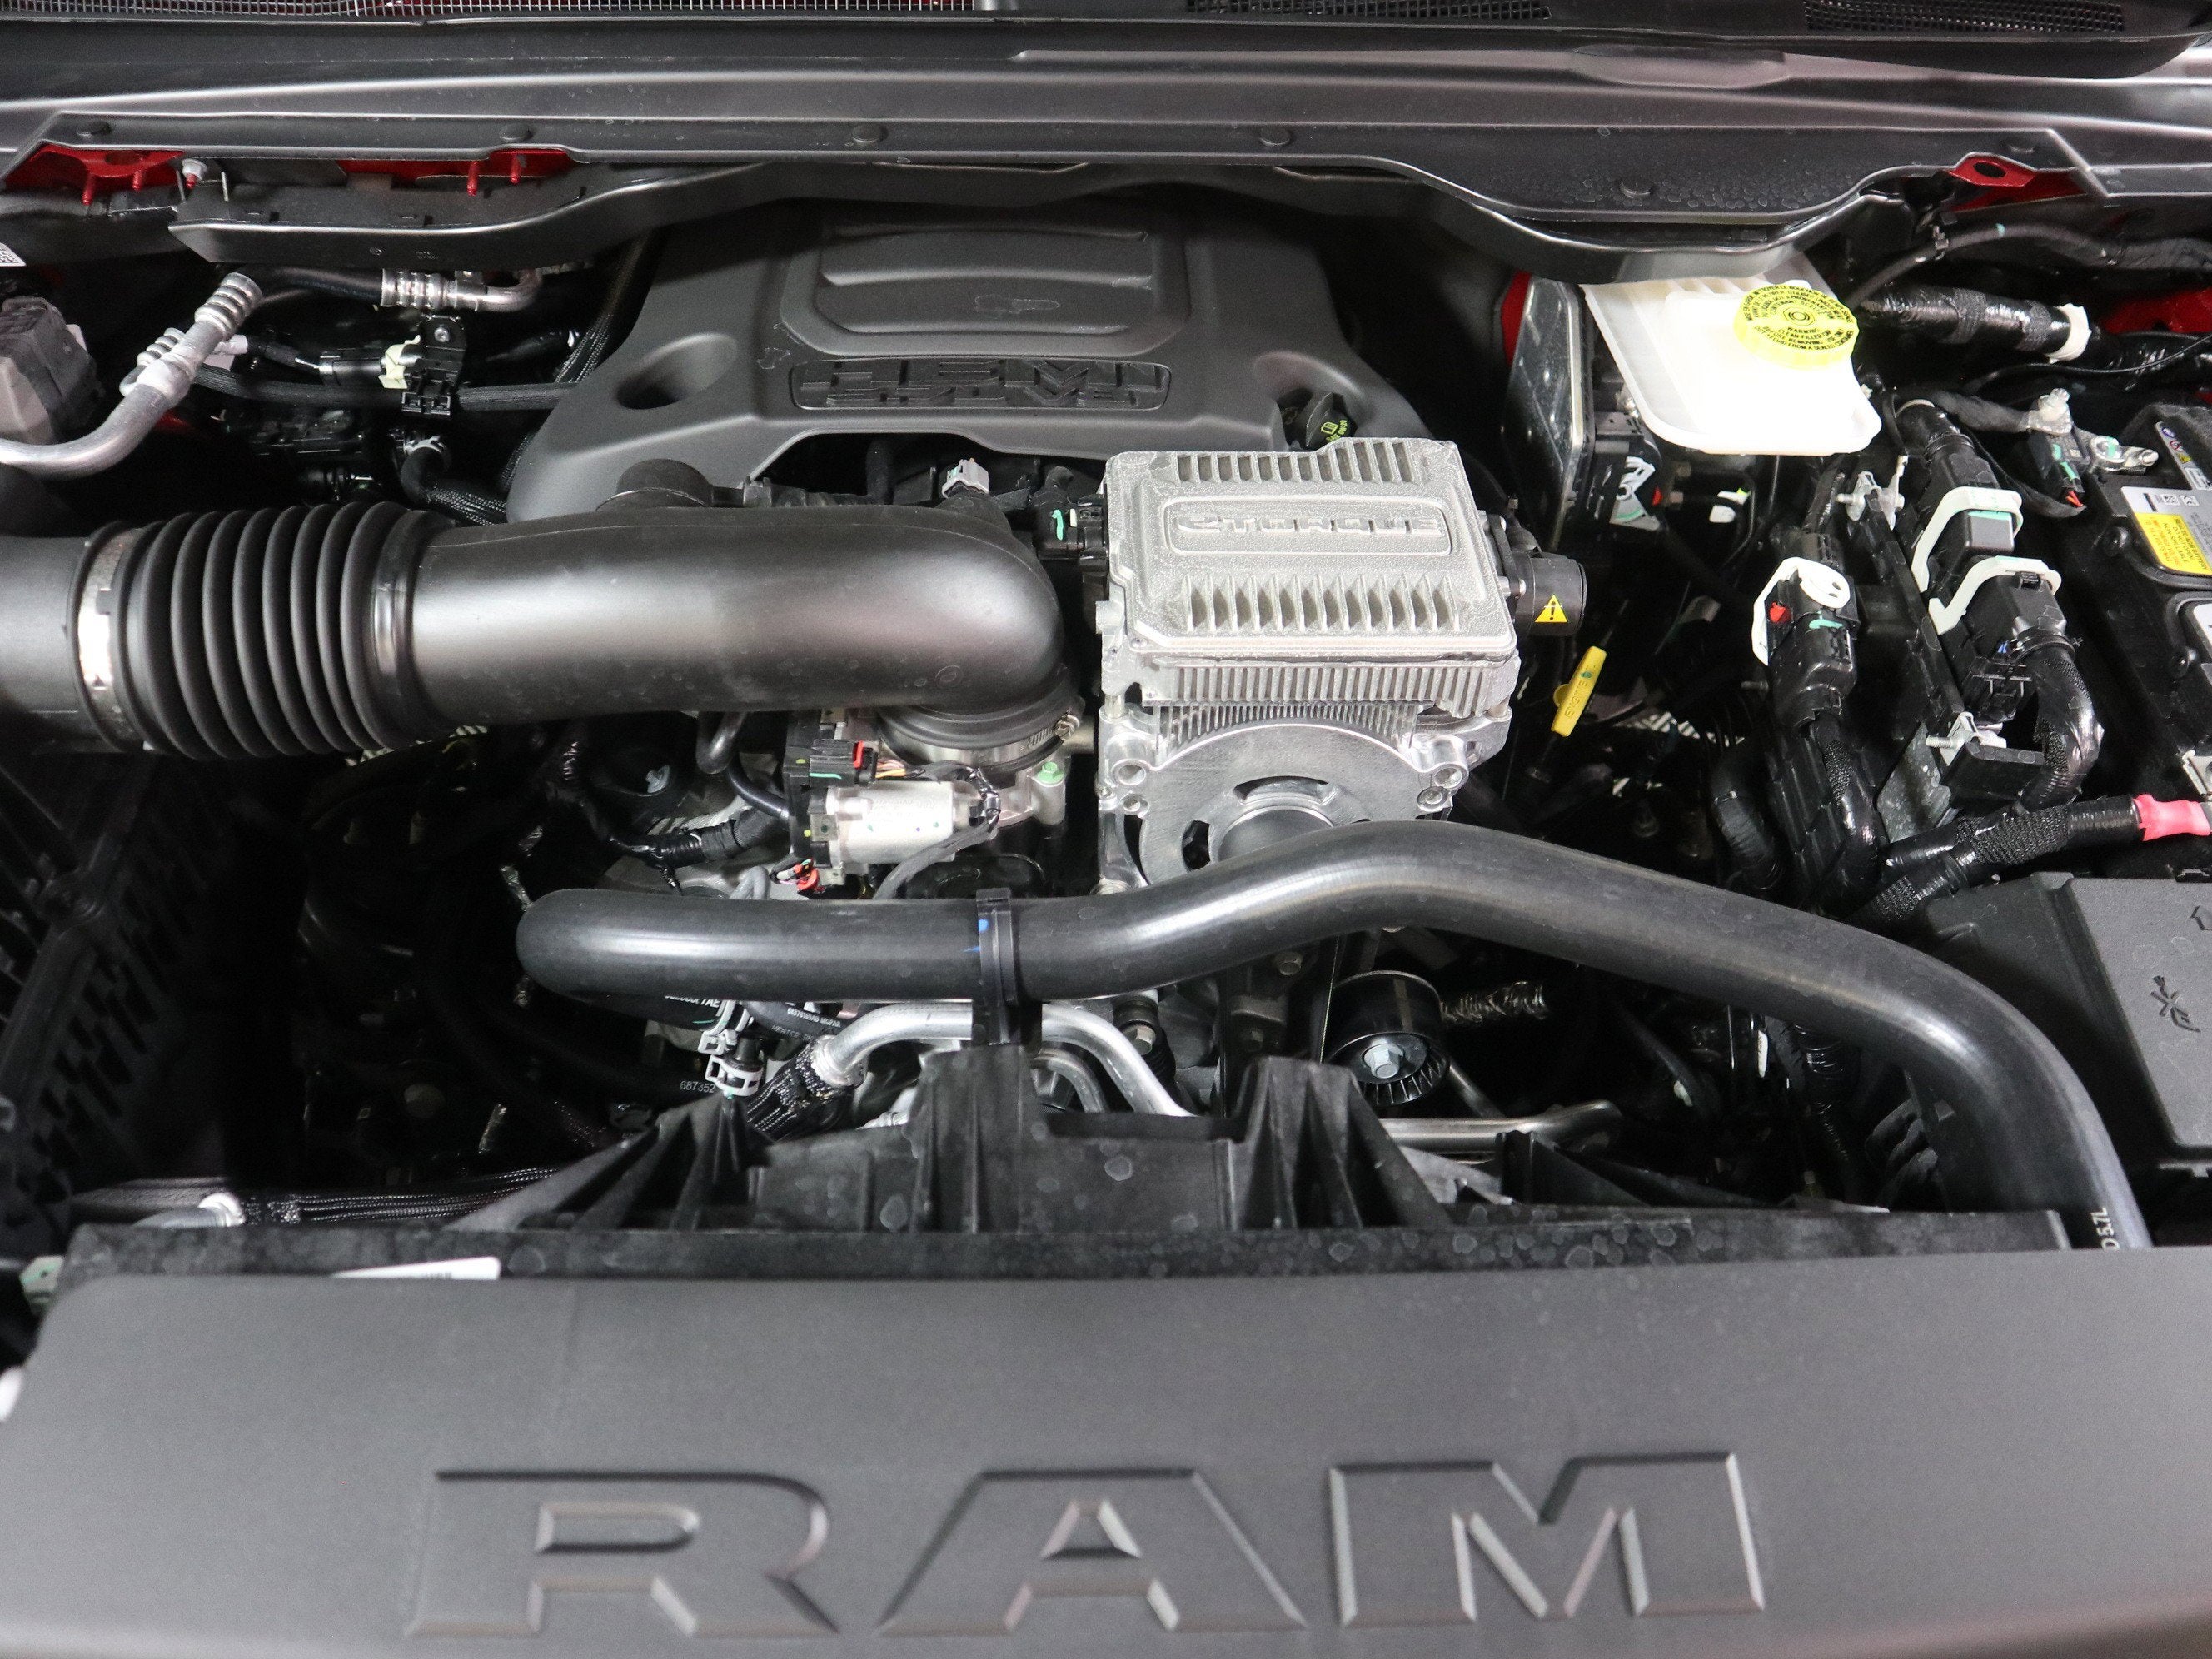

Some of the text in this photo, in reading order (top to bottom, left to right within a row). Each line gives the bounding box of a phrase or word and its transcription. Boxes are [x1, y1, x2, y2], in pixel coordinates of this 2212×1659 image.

[1777, 329, 1800, 338] CLEAN
[771, 1024, 800, 1039] HEATER
[405, 1452, 1766, 1639] RAM
